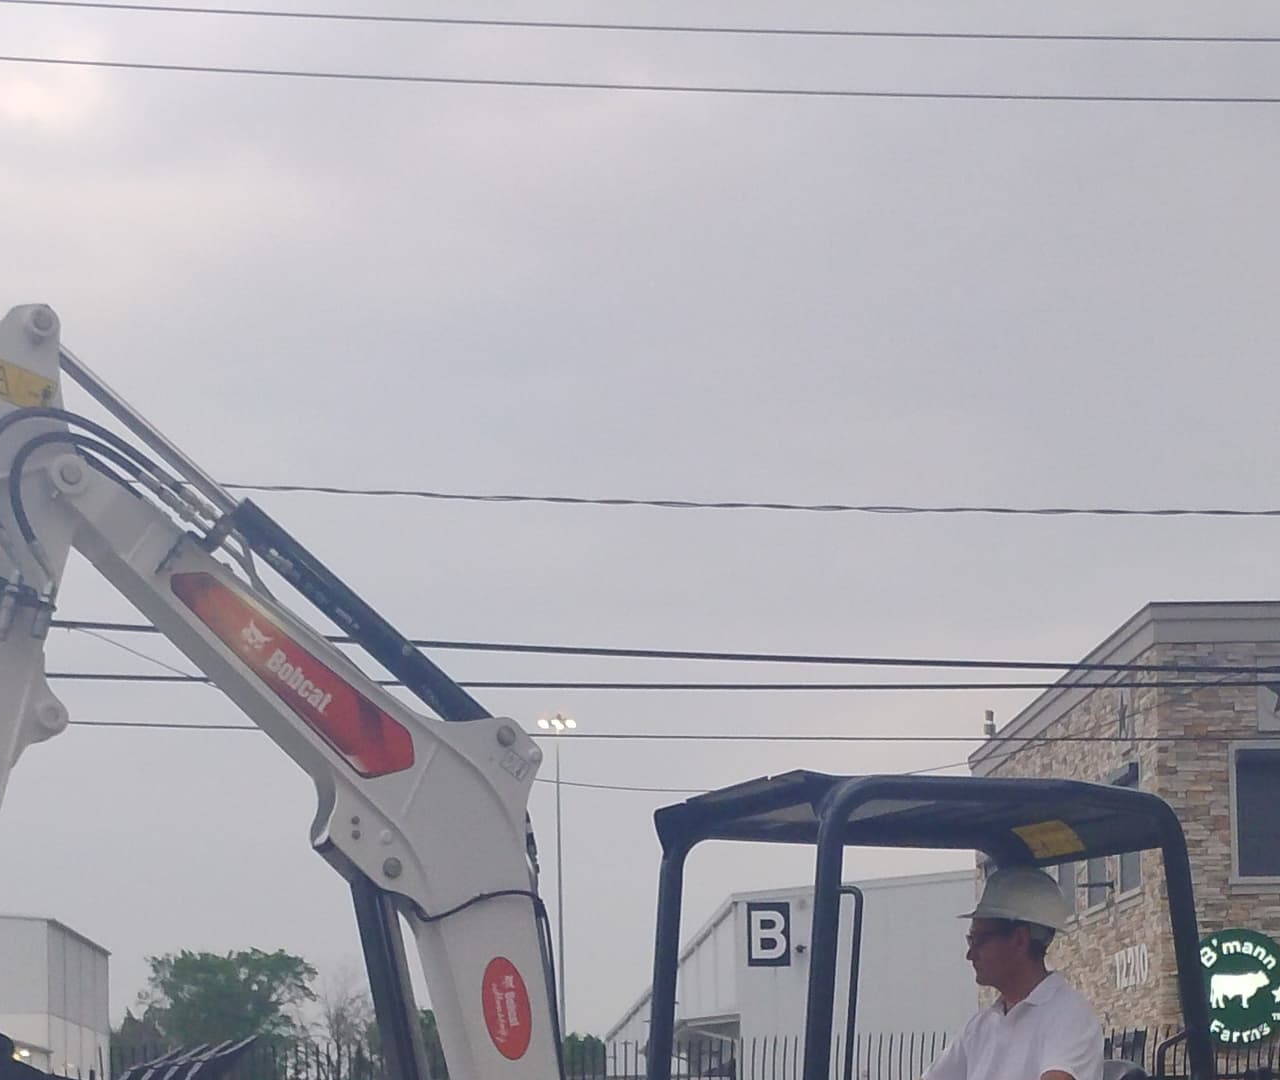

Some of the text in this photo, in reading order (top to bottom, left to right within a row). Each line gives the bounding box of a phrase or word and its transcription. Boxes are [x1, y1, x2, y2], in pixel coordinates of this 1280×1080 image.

[266, 648, 333, 713] Bobcat
[751, 910, 787, 959] B
[1200, 938, 1277, 970] B'mann
[1114, 943, 1149, 990] 12210
[1209, 1019, 1272, 1043] Farms
